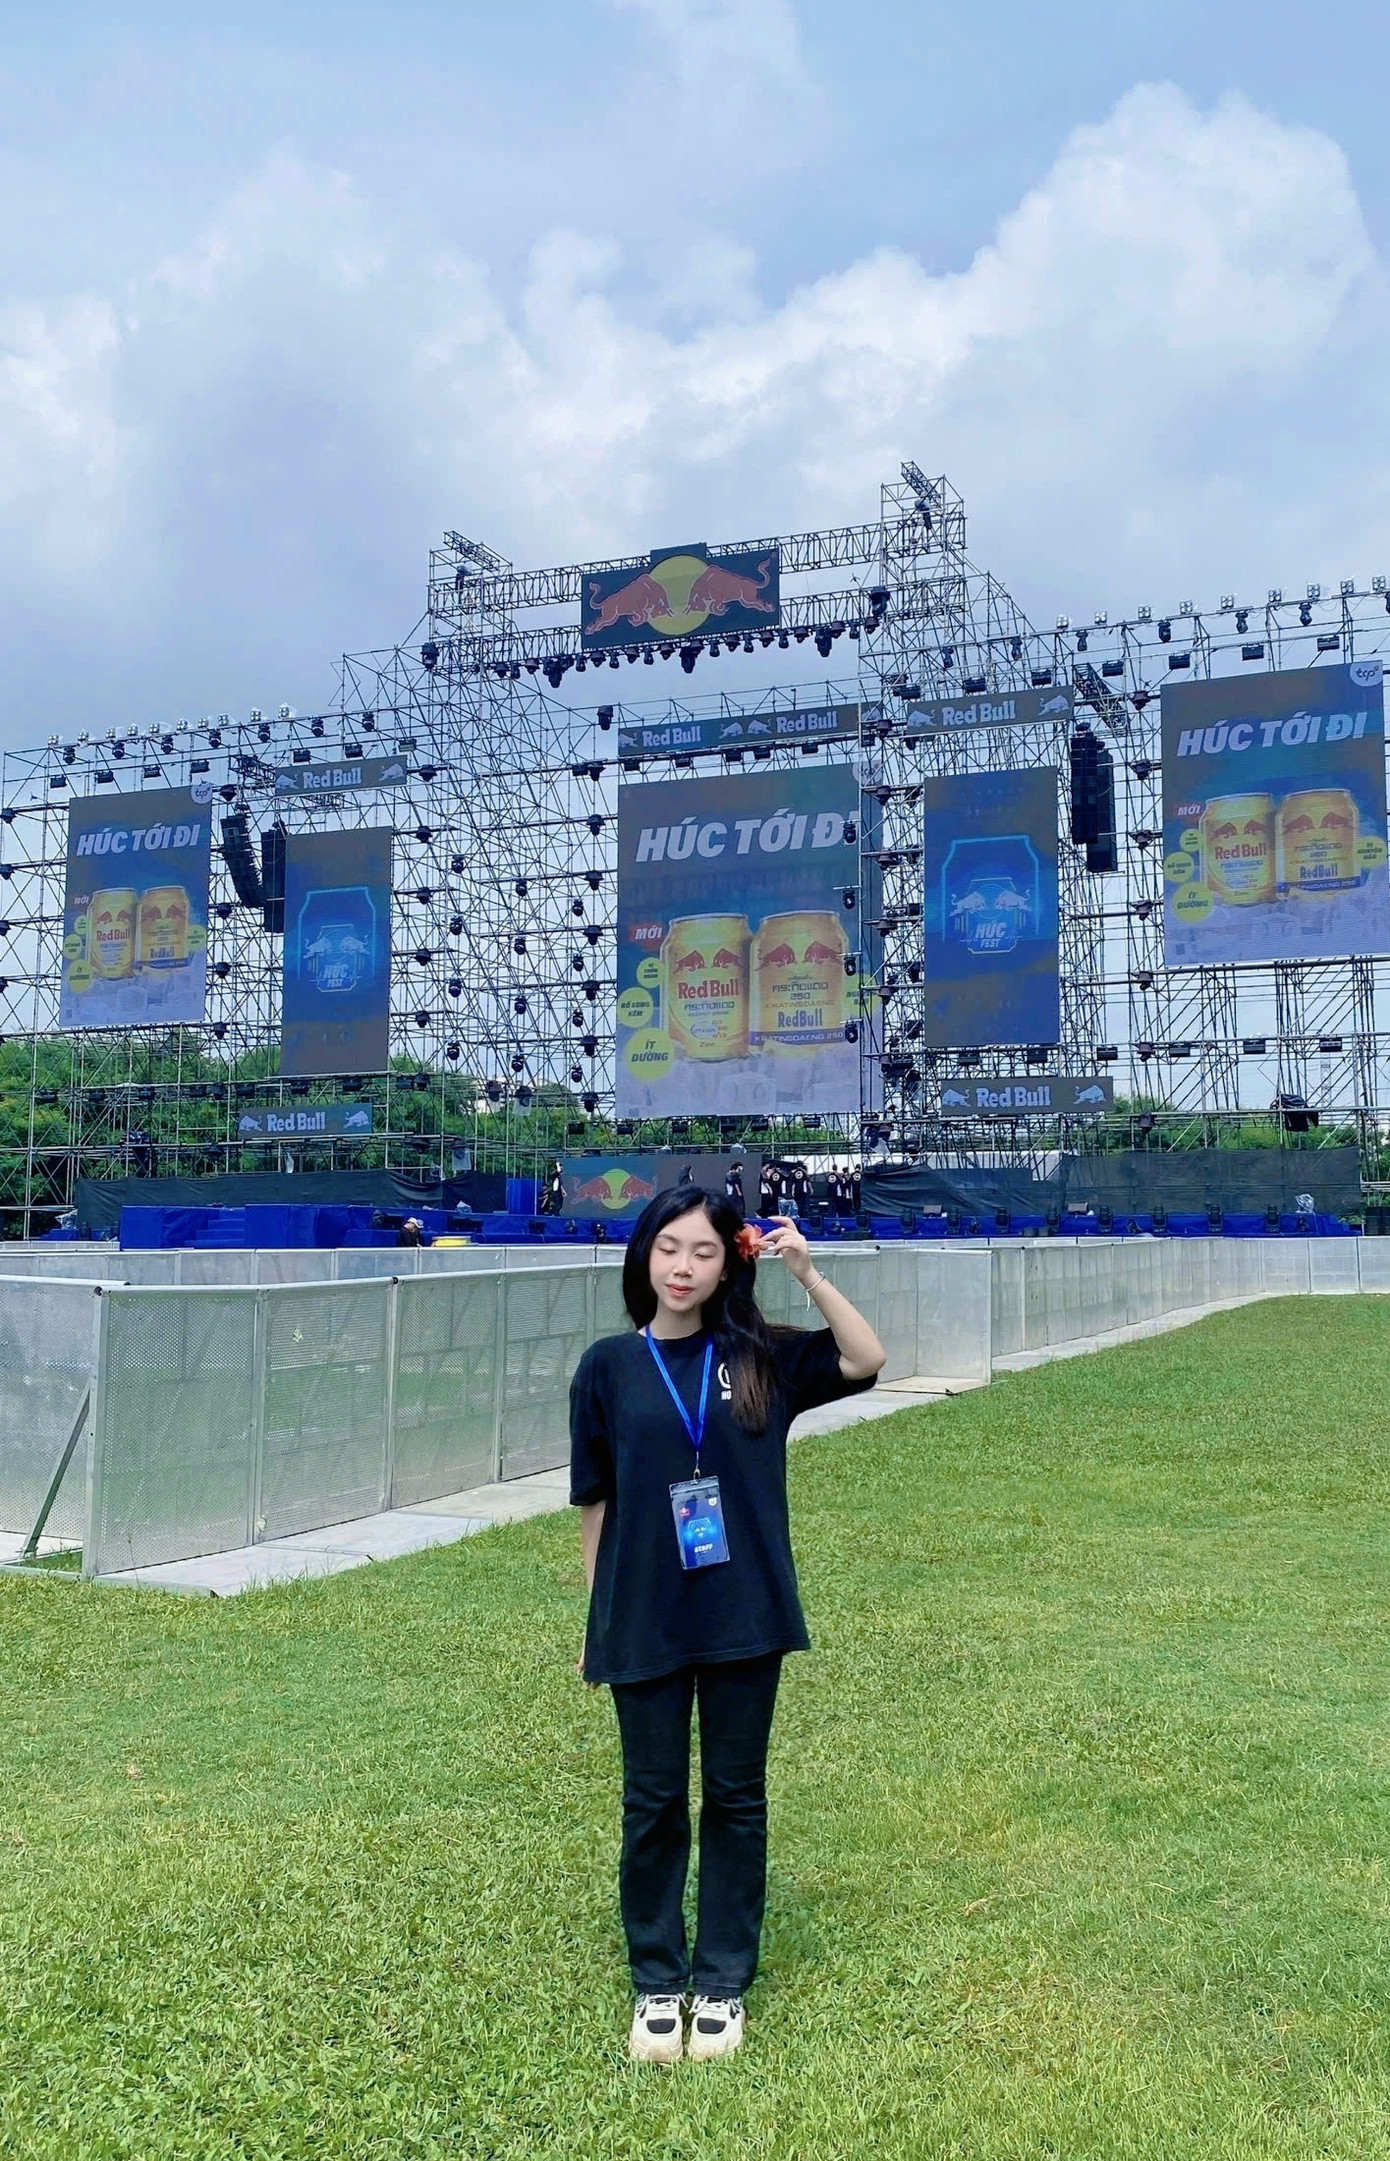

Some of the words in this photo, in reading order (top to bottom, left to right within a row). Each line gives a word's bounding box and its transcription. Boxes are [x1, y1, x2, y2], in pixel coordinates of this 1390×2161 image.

[942, 703, 977, 726] Red
[979, 700, 1016, 722] Bull
[642, 729, 671, 747] Red
[672, 726, 701, 745] Bull
[776, 714, 806, 734] Red
[807, 711, 837, 730] Bull
[1176, 720, 1254, 757] HÚC
[1260, 711, 1322, 748] TỚI
[1325, 711, 1368, 742] ĐI
[302, 770, 331, 789] Red
[332, 767, 362, 787] Bull
[76, 827, 129, 857] HÚC
[131, 823, 173, 852] TỚI
[173, 824, 201, 848] ĐI
[635, 816, 728, 863] HÚC
[734, 808, 809, 855] TỚI
[1214, 844, 1240, 860] Red
[1241, 842, 1267, 858] Bull
[96, 929, 114, 942] Red
[634, 924, 663, 941] MỚI
[980, 938, 1001, 948] FEST
[677, 980, 708, 1000] Red
[709, 977, 740, 997] Bull
[777, 1008, 823, 1028] RedBull
[644, 1039, 656, 1050] ÍT
[976, 1086, 1012, 1108] Red
[1013, 1085, 1052, 1107] Bull
[266, 1113, 295, 1132] Red
[297, 1111, 326, 1131] Bull
